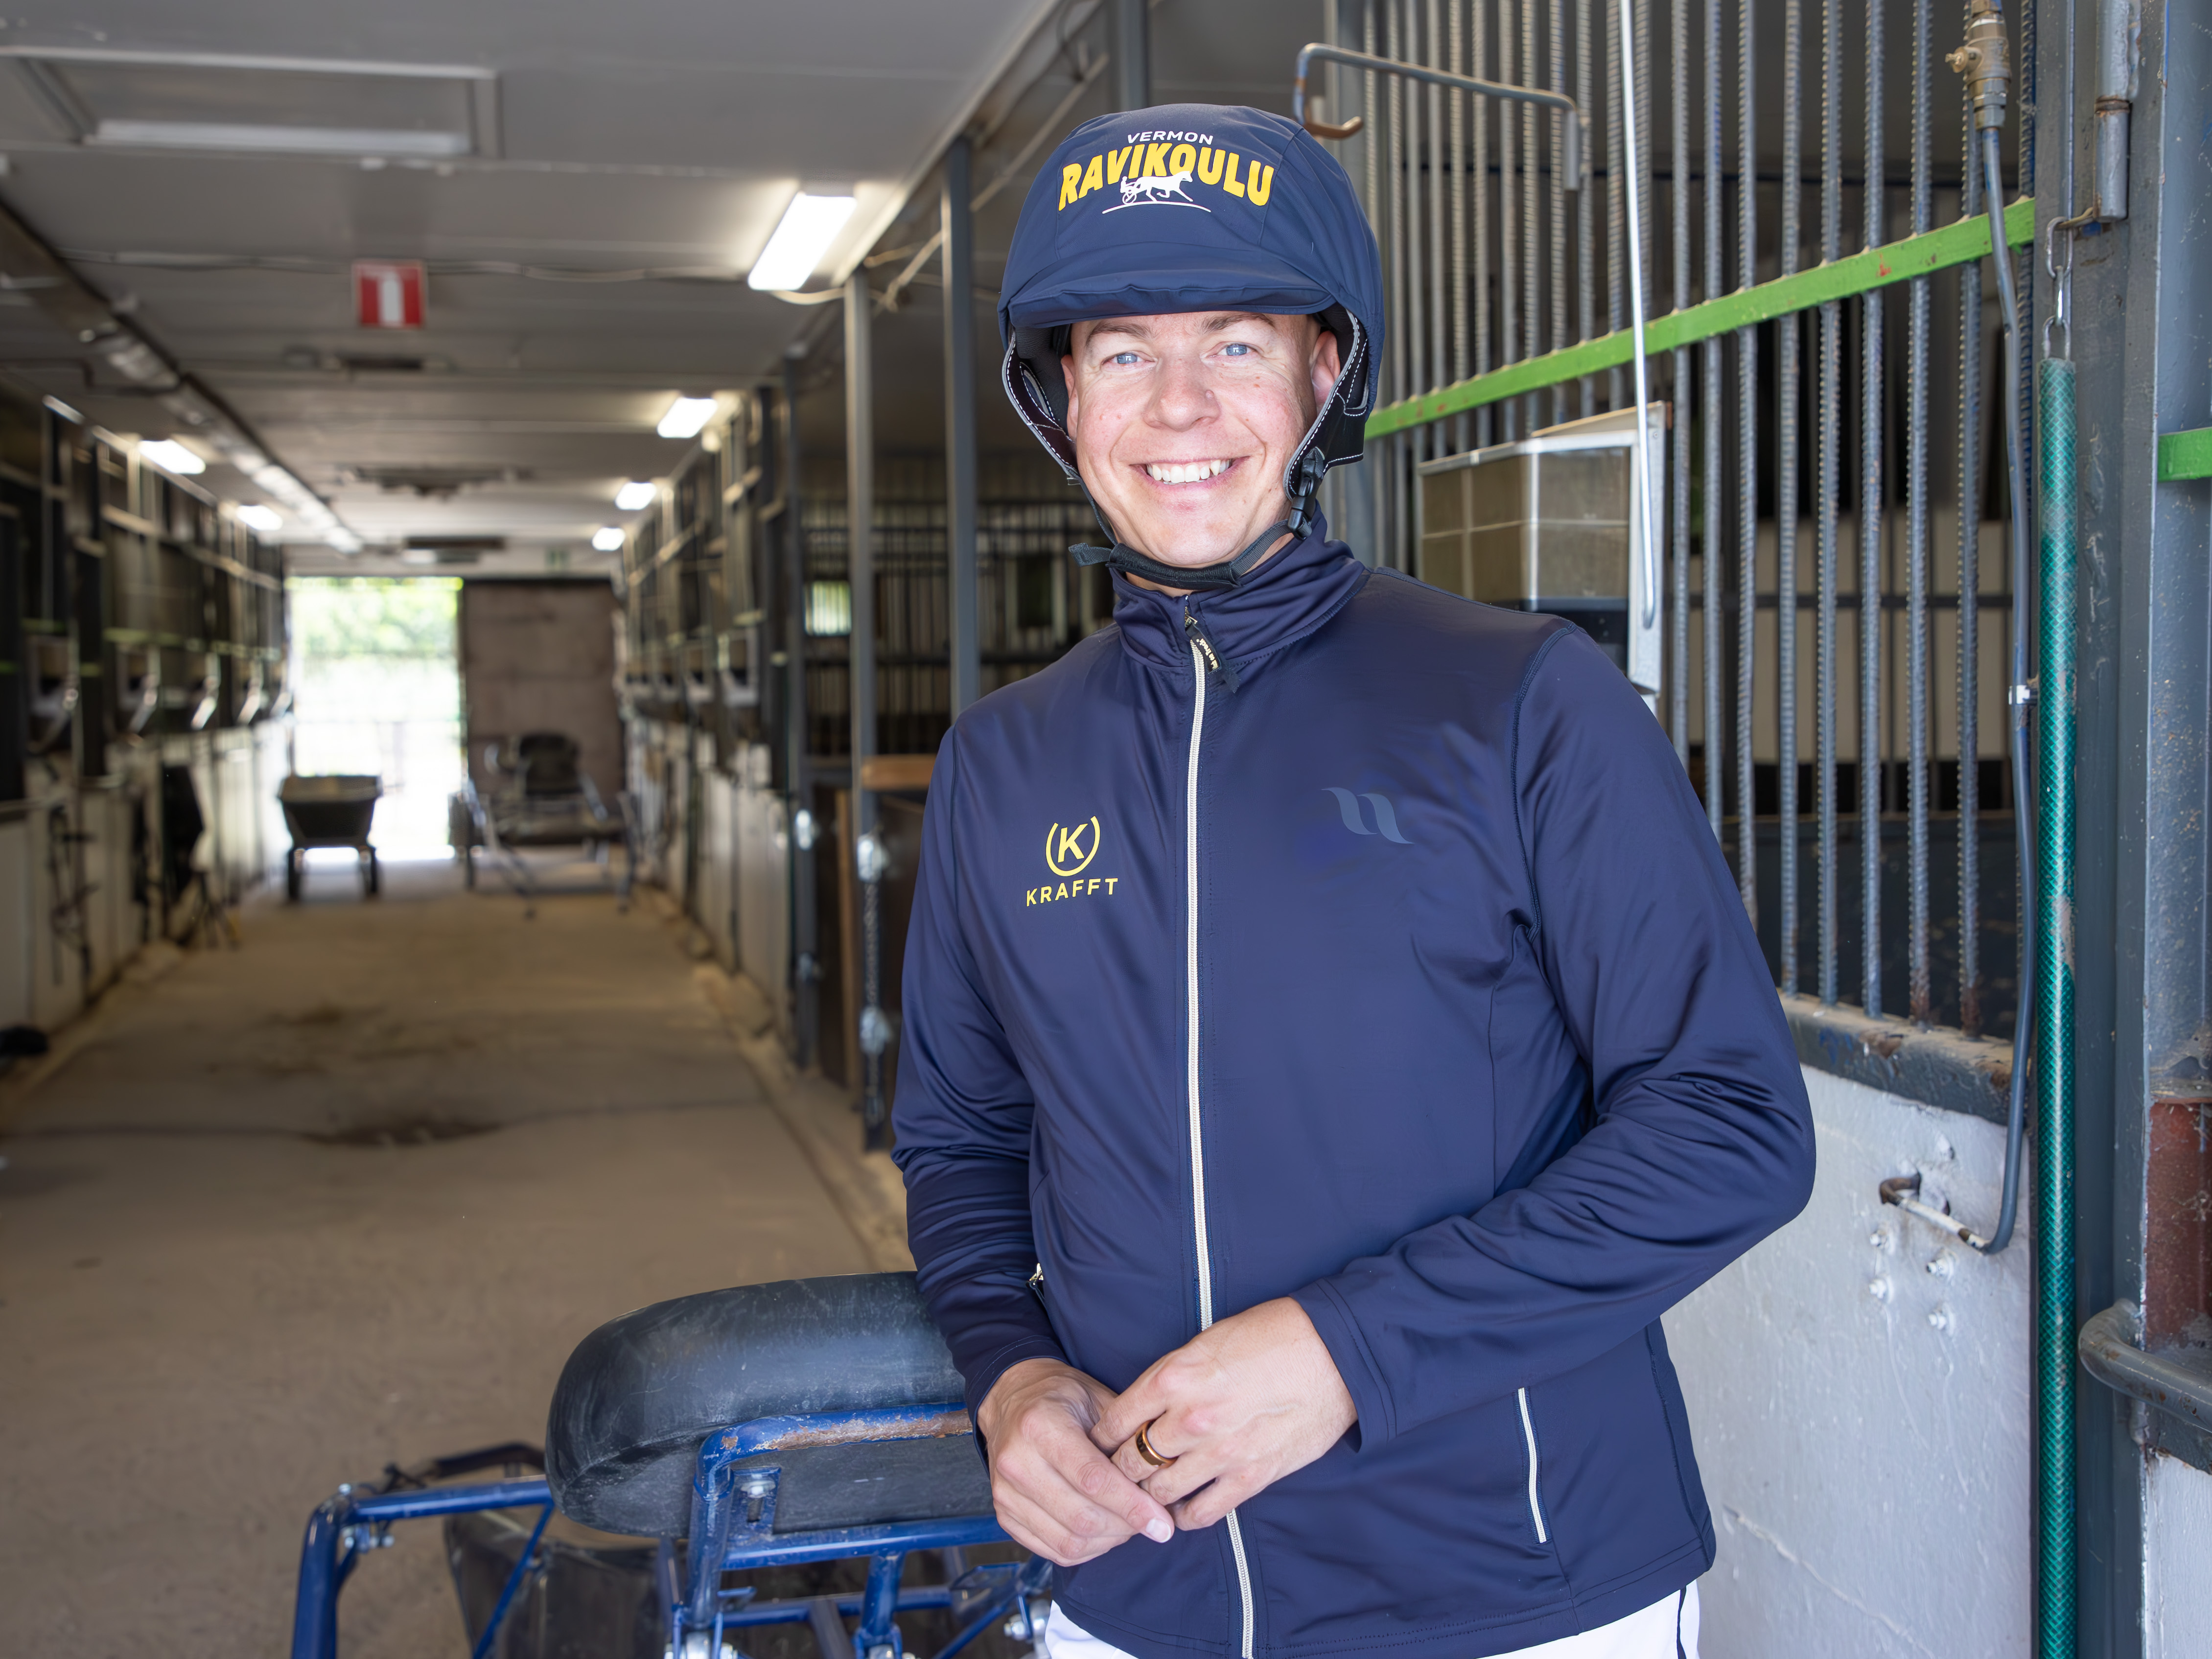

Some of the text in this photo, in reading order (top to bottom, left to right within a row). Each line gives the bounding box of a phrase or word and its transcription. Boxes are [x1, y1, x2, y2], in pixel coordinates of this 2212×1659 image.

[1127, 131, 1213, 145] VERMON
[1058, 142, 1275, 211] RAVIKOULU
[1057, 823, 1088, 863] K
[1026, 878, 1118, 907] KRAFFT
